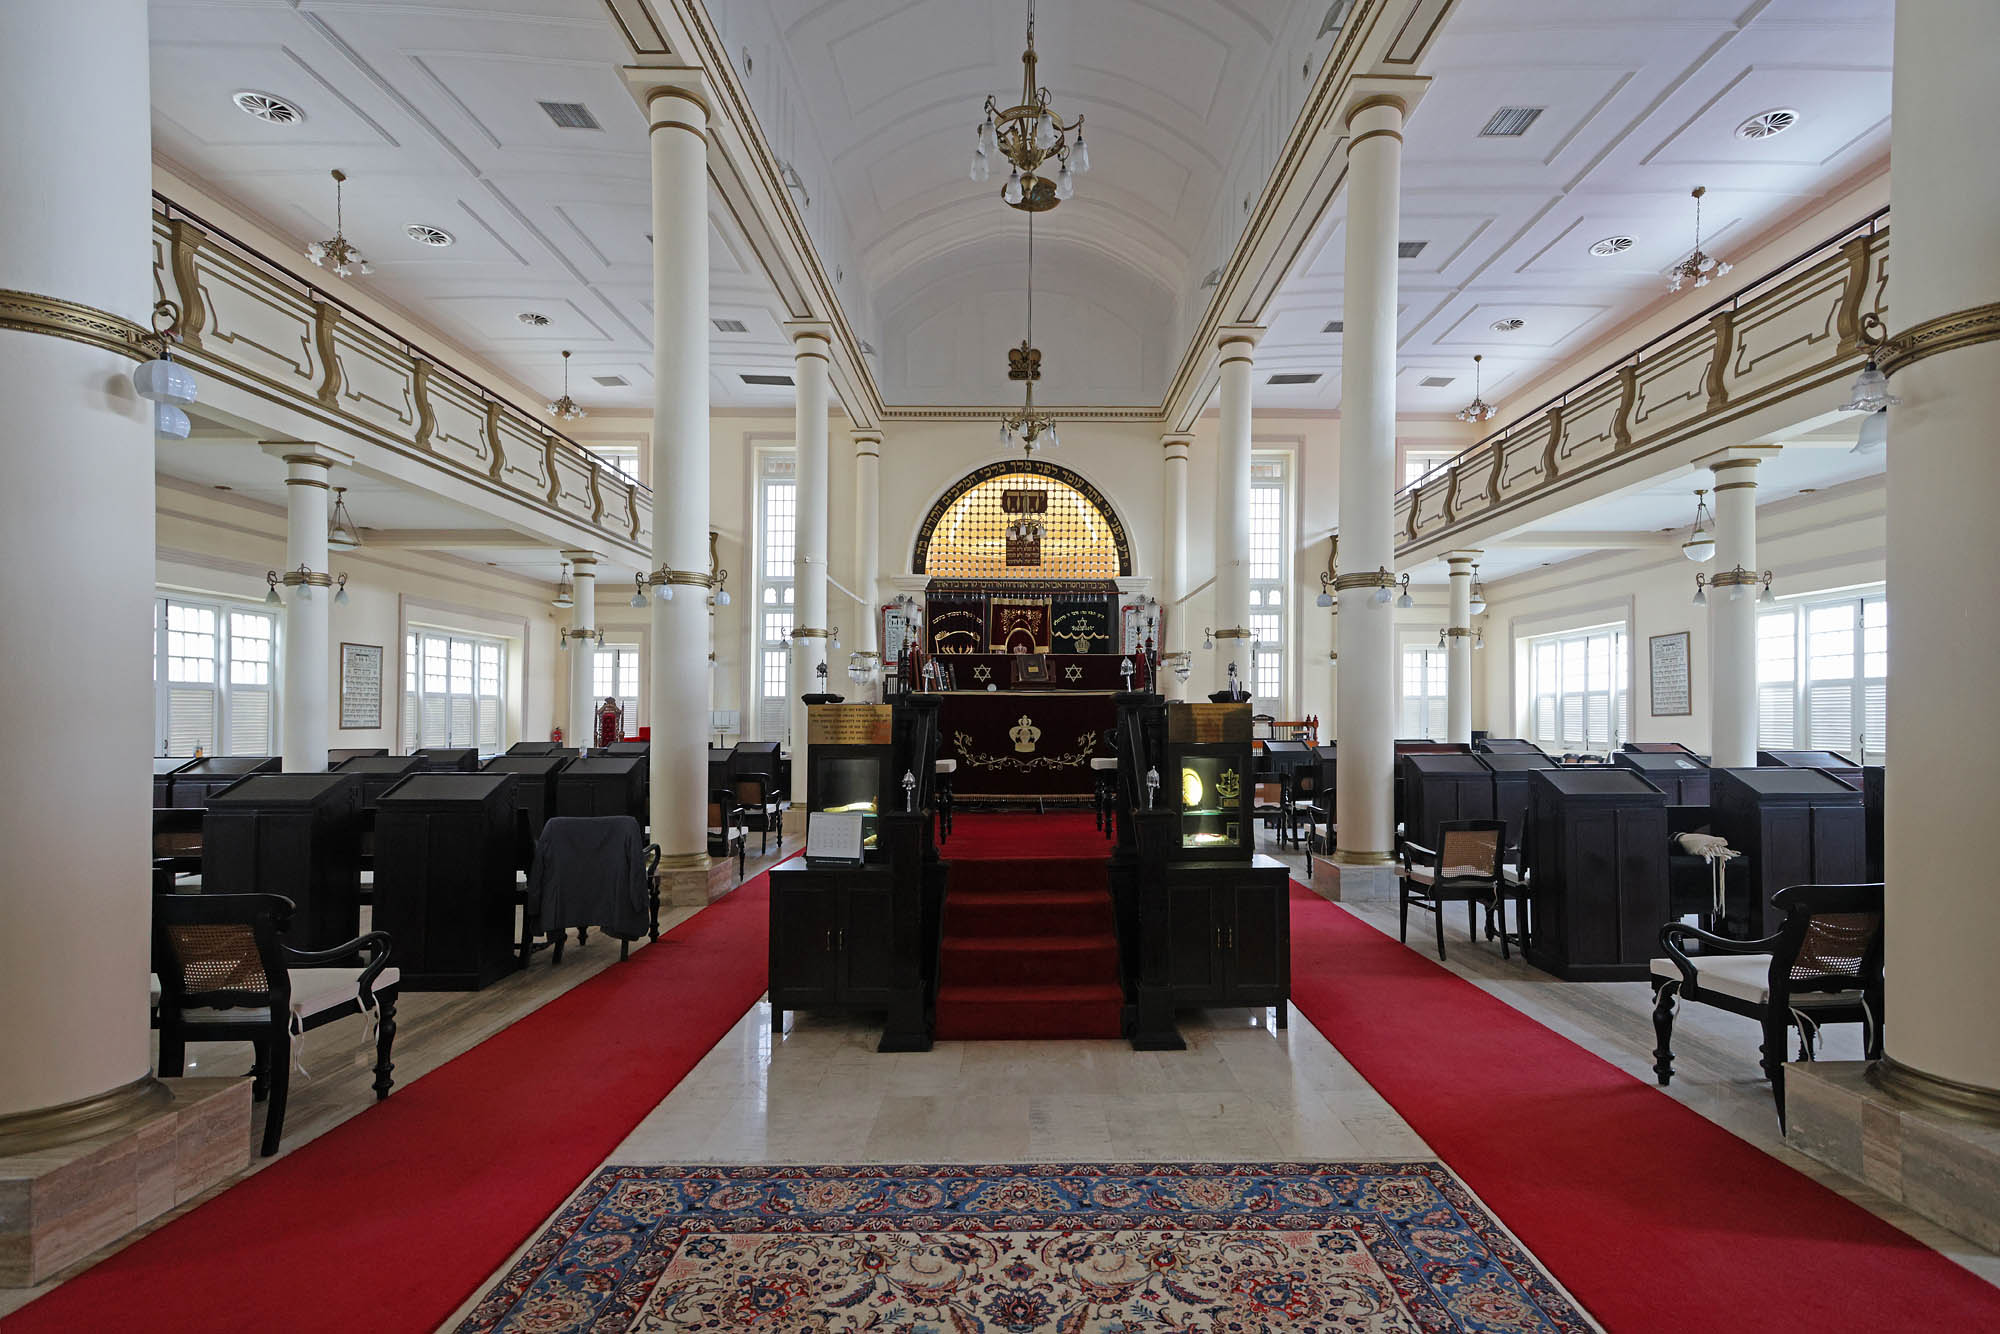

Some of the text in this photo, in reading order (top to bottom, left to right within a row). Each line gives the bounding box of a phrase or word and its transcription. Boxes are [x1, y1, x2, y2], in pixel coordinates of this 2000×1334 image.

[980, 463, 1006, 478] מלכי
[1010, 461, 1032, 473] מלך
[1036, 462, 1058, 475] לפני
[1062, 470, 1084, 488] עומד
[942, 475, 978, 505] המלכים
[1083, 484, 1103, 504] אתה
